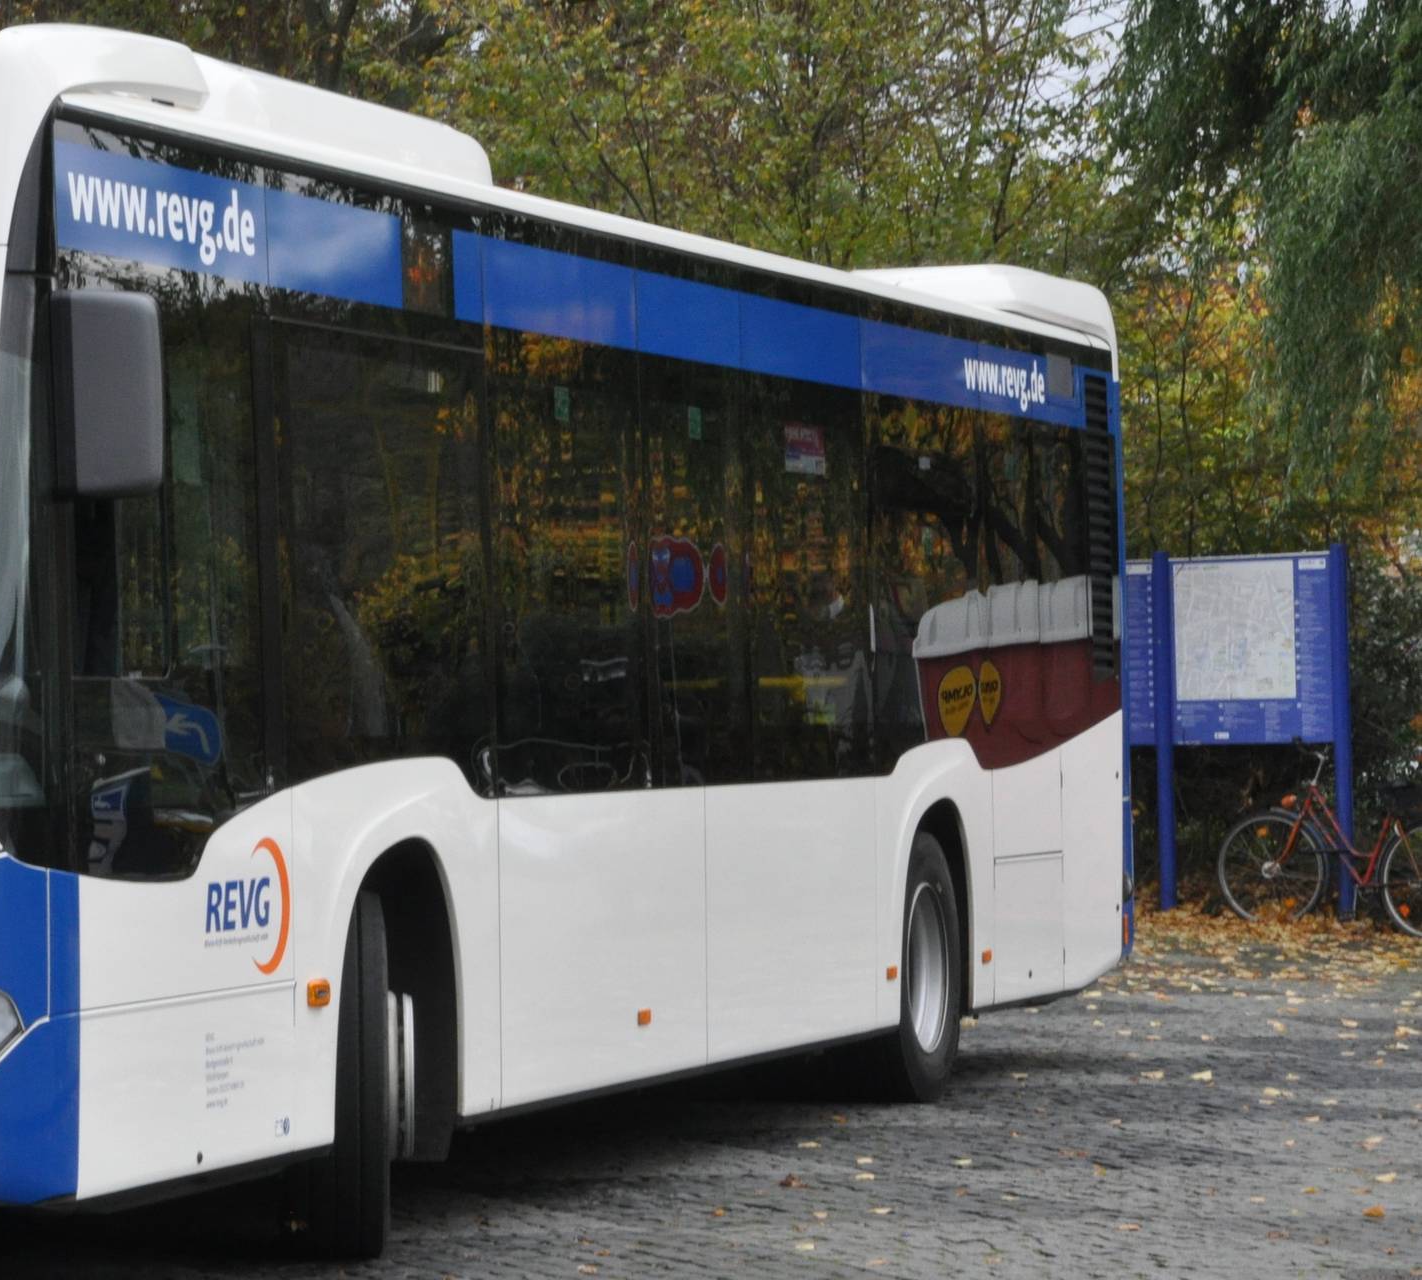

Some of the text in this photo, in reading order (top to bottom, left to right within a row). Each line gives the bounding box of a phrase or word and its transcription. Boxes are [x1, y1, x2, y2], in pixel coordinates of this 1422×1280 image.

[67, 172, 256, 265] www.revg.de
[964, 358, 1046, 413] www.revg.de
[205, 876, 271, 934] REVG
